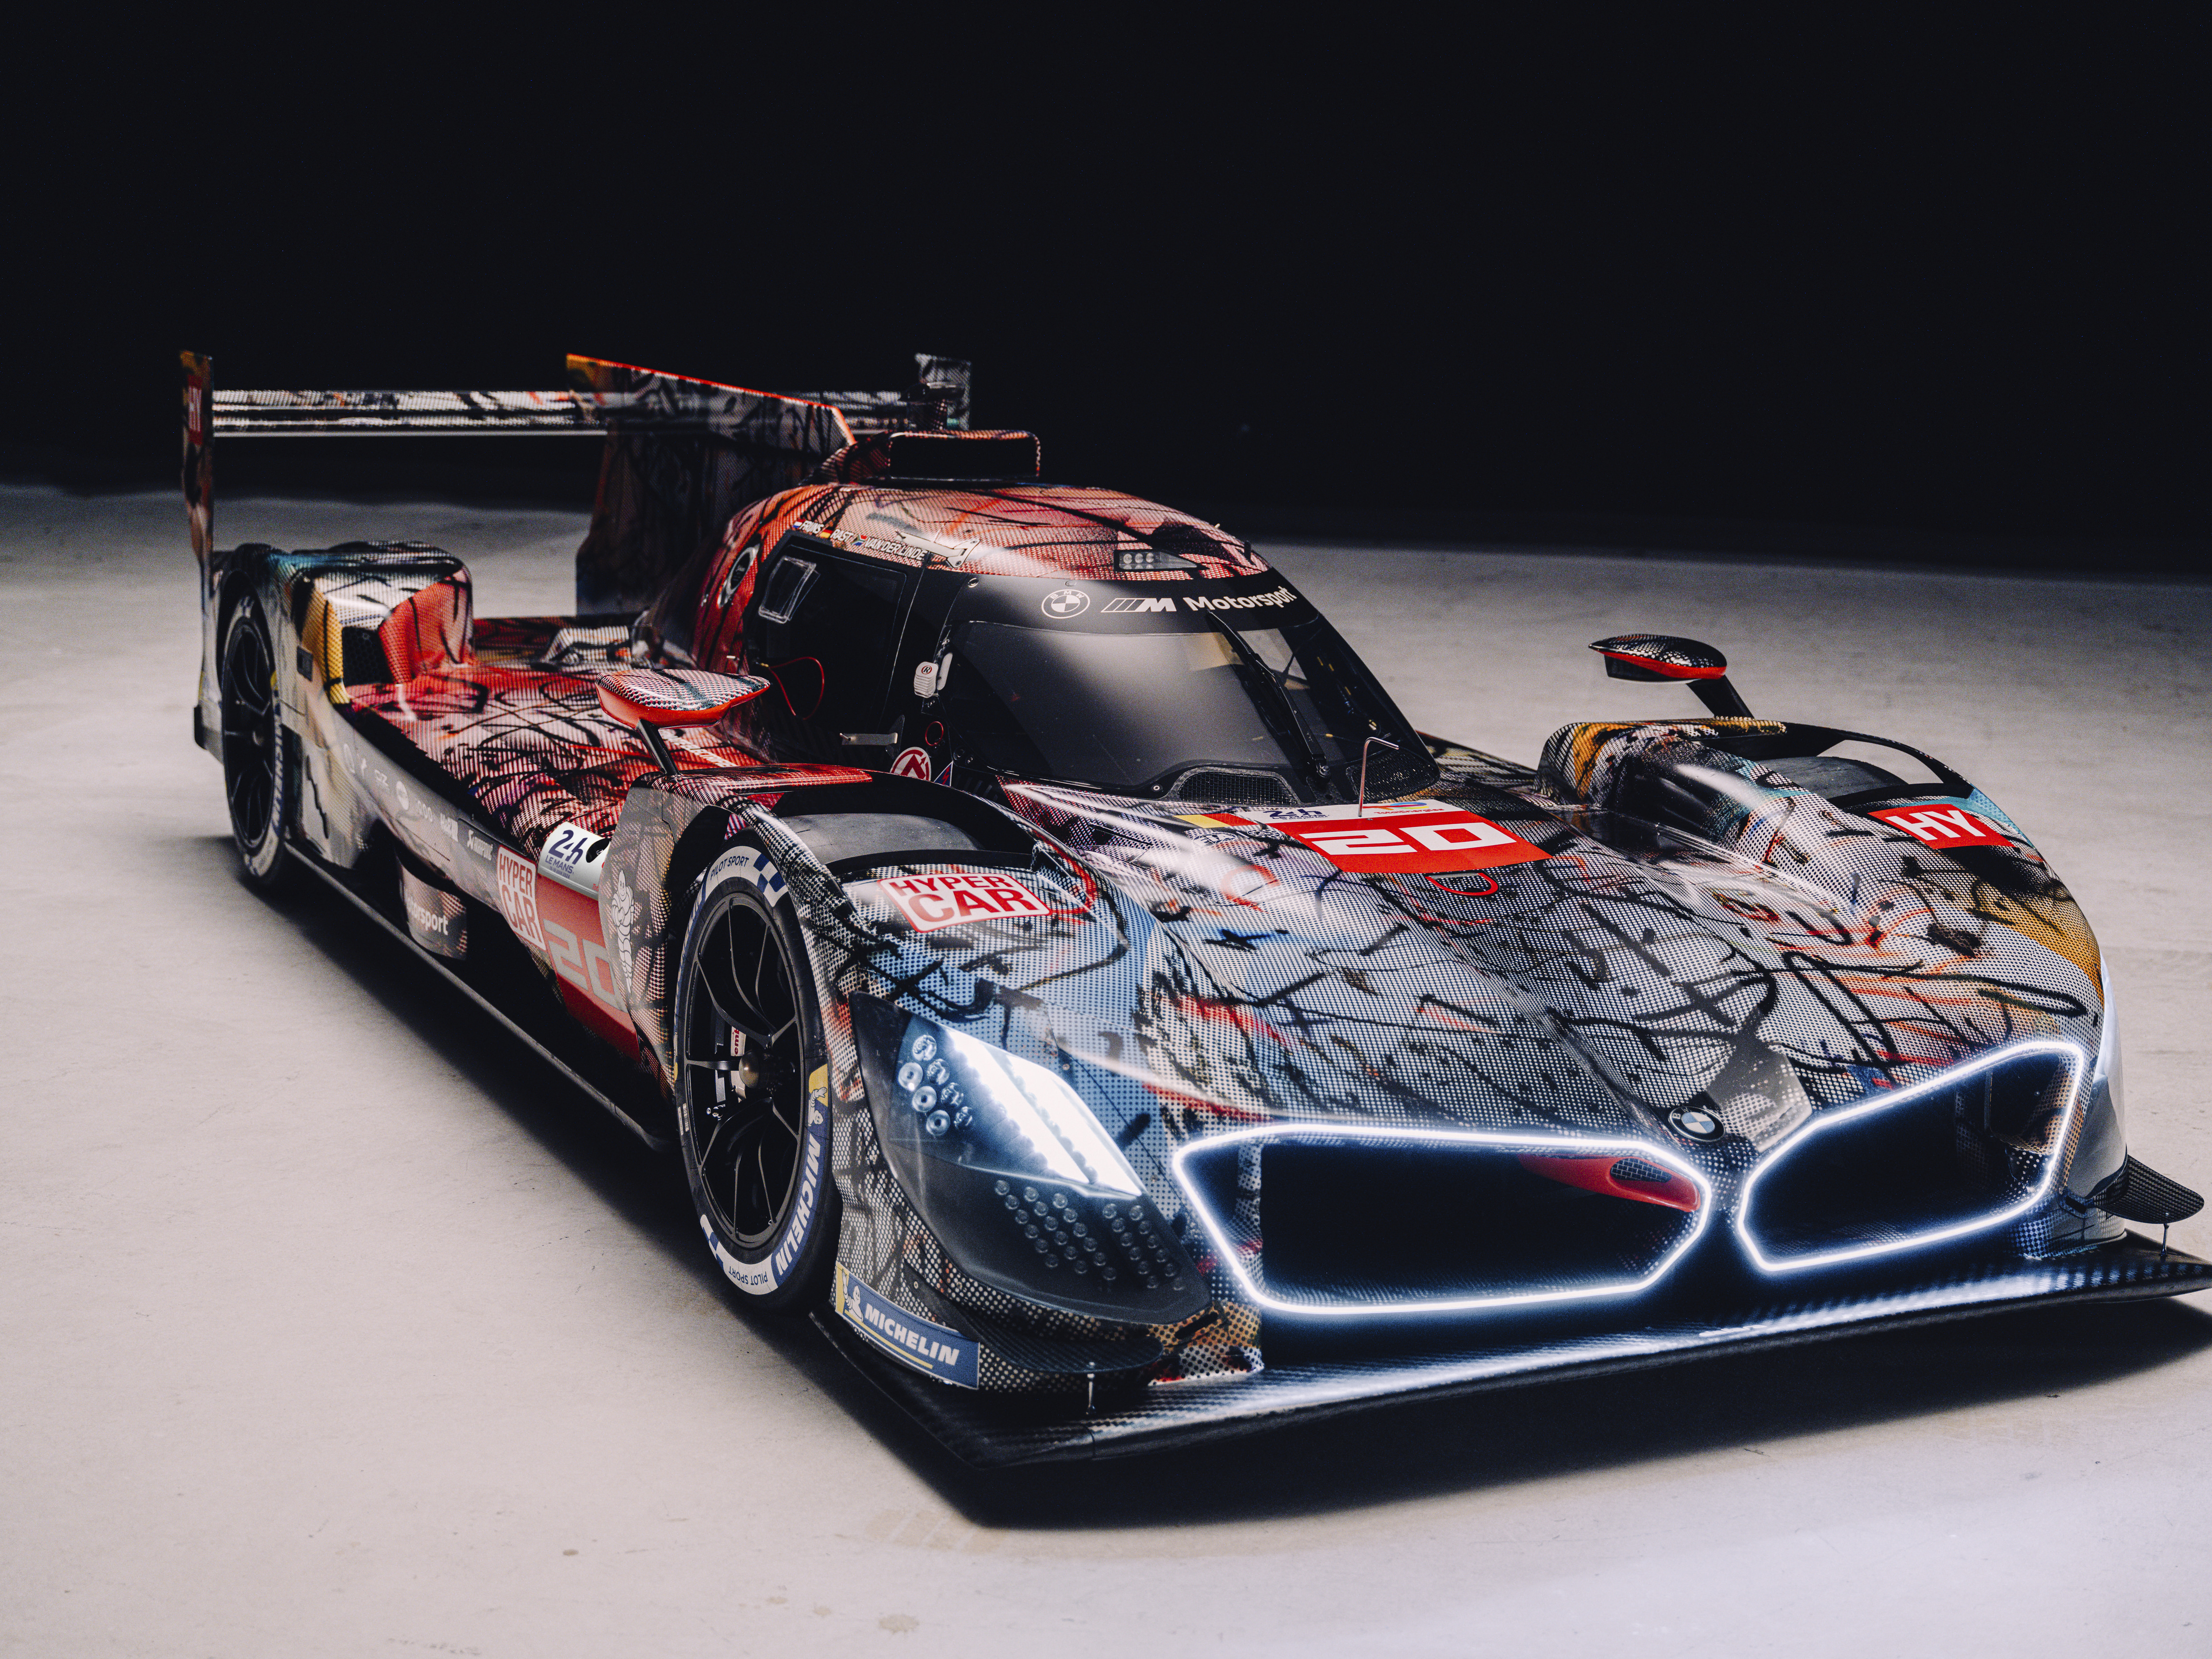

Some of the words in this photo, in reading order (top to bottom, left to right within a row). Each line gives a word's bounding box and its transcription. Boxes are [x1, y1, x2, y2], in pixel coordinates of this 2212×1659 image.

[830, 529, 854, 542] RAST
[864, 537, 885, 550] VAN
[880, 541, 902, 554] DER
[898, 545, 928, 561] LINDE
[1183, 586, 1297, 611] Motorsport
[1263, 809, 1323, 818] 24h
[1885, 810, 1987, 841] HY
[548, 830, 588, 865] 24h
[1298, 822, 1517, 855] 20
[499, 853, 533, 899] HYPER
[545, 855, 554, 864] LE
[553, 859, 574, 874] MANS
[710, 858, 728, 881] PILOT
[727, 855, 750, 867] SPORT
[888, 876, 1014, 897] HYPER
[502, 884, 543, 944] CAR
[908, 888, 1041, 923] CAR
[543, 918, 629, 1014] 20
[775, 1133, 821, 1276] MICHELIN
[728, 1266, 749, 1285] SPORT
[750, 1271, 768, 1286] PILOT
[864, 1302, 960, 1366] MICHELIN
